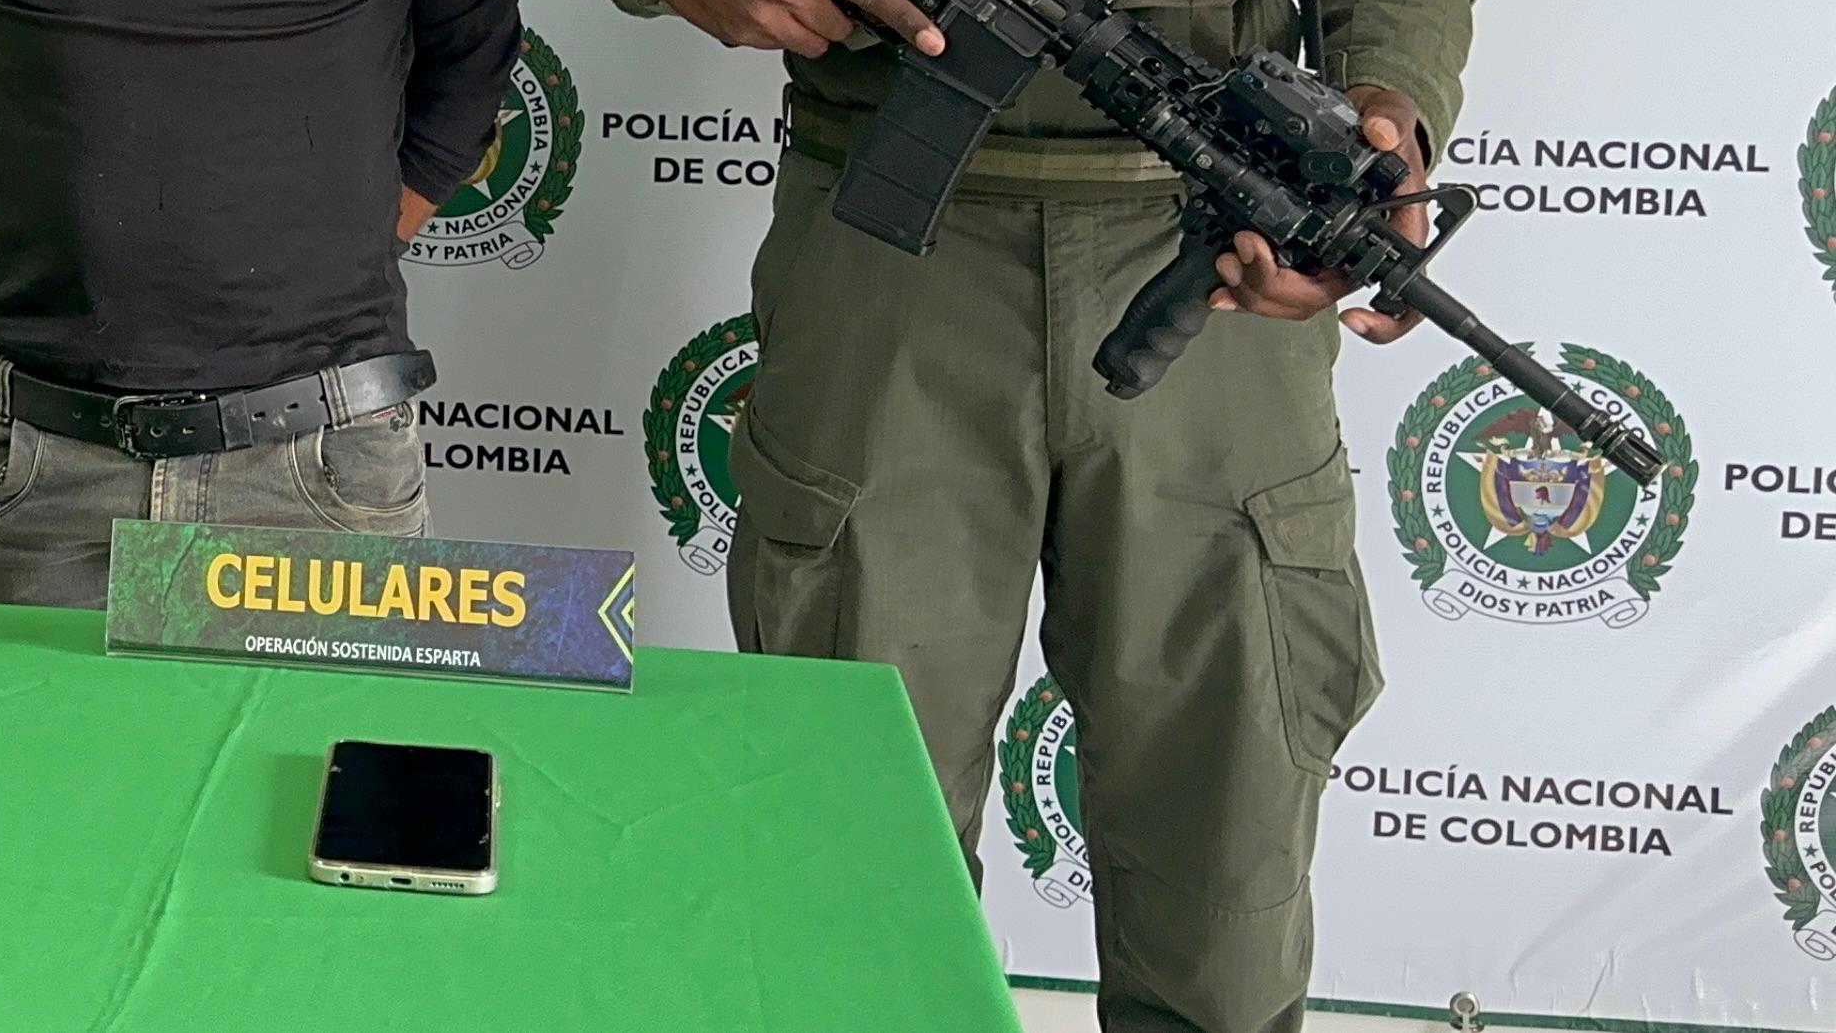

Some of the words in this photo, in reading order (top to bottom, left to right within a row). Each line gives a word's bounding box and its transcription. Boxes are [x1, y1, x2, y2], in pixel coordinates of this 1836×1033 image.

[513, 67, 548, 151] LOMBIA
[603, 109, 760, 142] POLICÍA
[654, 157, 703, 184] DE
[1535, 140, 1769, 172] NACIONAL
[445, 176, 538, 235] NACIONAL
[425, 244, 438, 259] Y
[444, 233, 513, 260] PATRIA
[419, 401, 624, 435] NACIONAL
[680, 350, 753, 453] REPÚBLICA
[1427, 384, 1507, 492] REPÚBLICA
[425, 443, 570, 475] LOMBIA
[691, 480, 736, 531] POLIC
[1781, 511, 1836, 540] DE
[1437, 521, 1507, 585] POLICÍA
[1538, 530, 1644, 590] NACIONAL
[206, 553, 527, 627] CELULARES
[1458, 582, 1510, 612] DIOS
[1515, 601, 1528, 615] Y
[1536, 590, 1614, 616] PATRIA
[245, 635, 328, 657] OPERACIÓN
[331, 641, 413, 663] SOSTENIDA
[416, 647, 481, 667] ESPARTA
[1502, 776, 1733, 815] NACIONAL
[1374, 812, 1426, 840] DE
[1441, 817, 1671, 856] COLOMBIA
